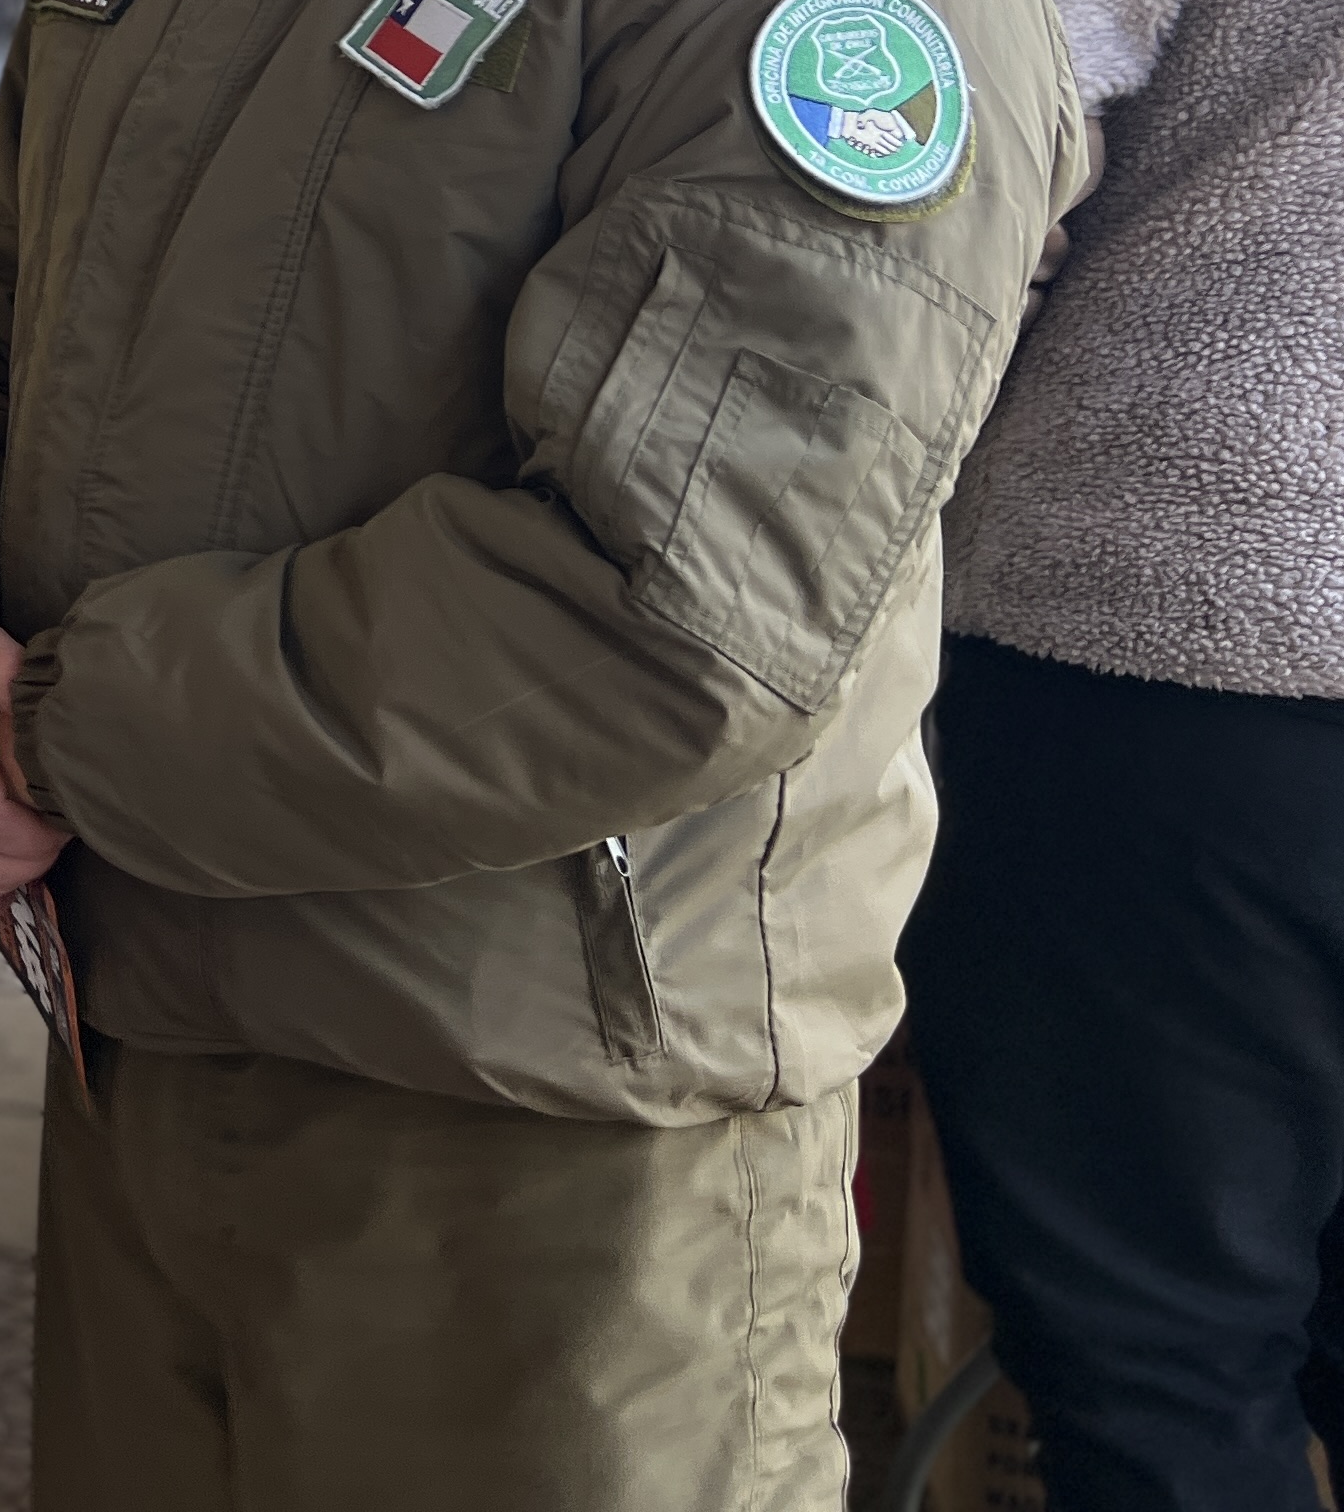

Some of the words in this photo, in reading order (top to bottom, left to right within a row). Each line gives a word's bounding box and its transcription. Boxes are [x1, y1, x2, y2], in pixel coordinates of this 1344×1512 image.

[763, 46, 783, 104] OFICINA
[773, 22, 794, 45] DE
[888, 0, 956, 88] COMUNITARIA
[877, 139, 951, 192] COYHAIQUE
